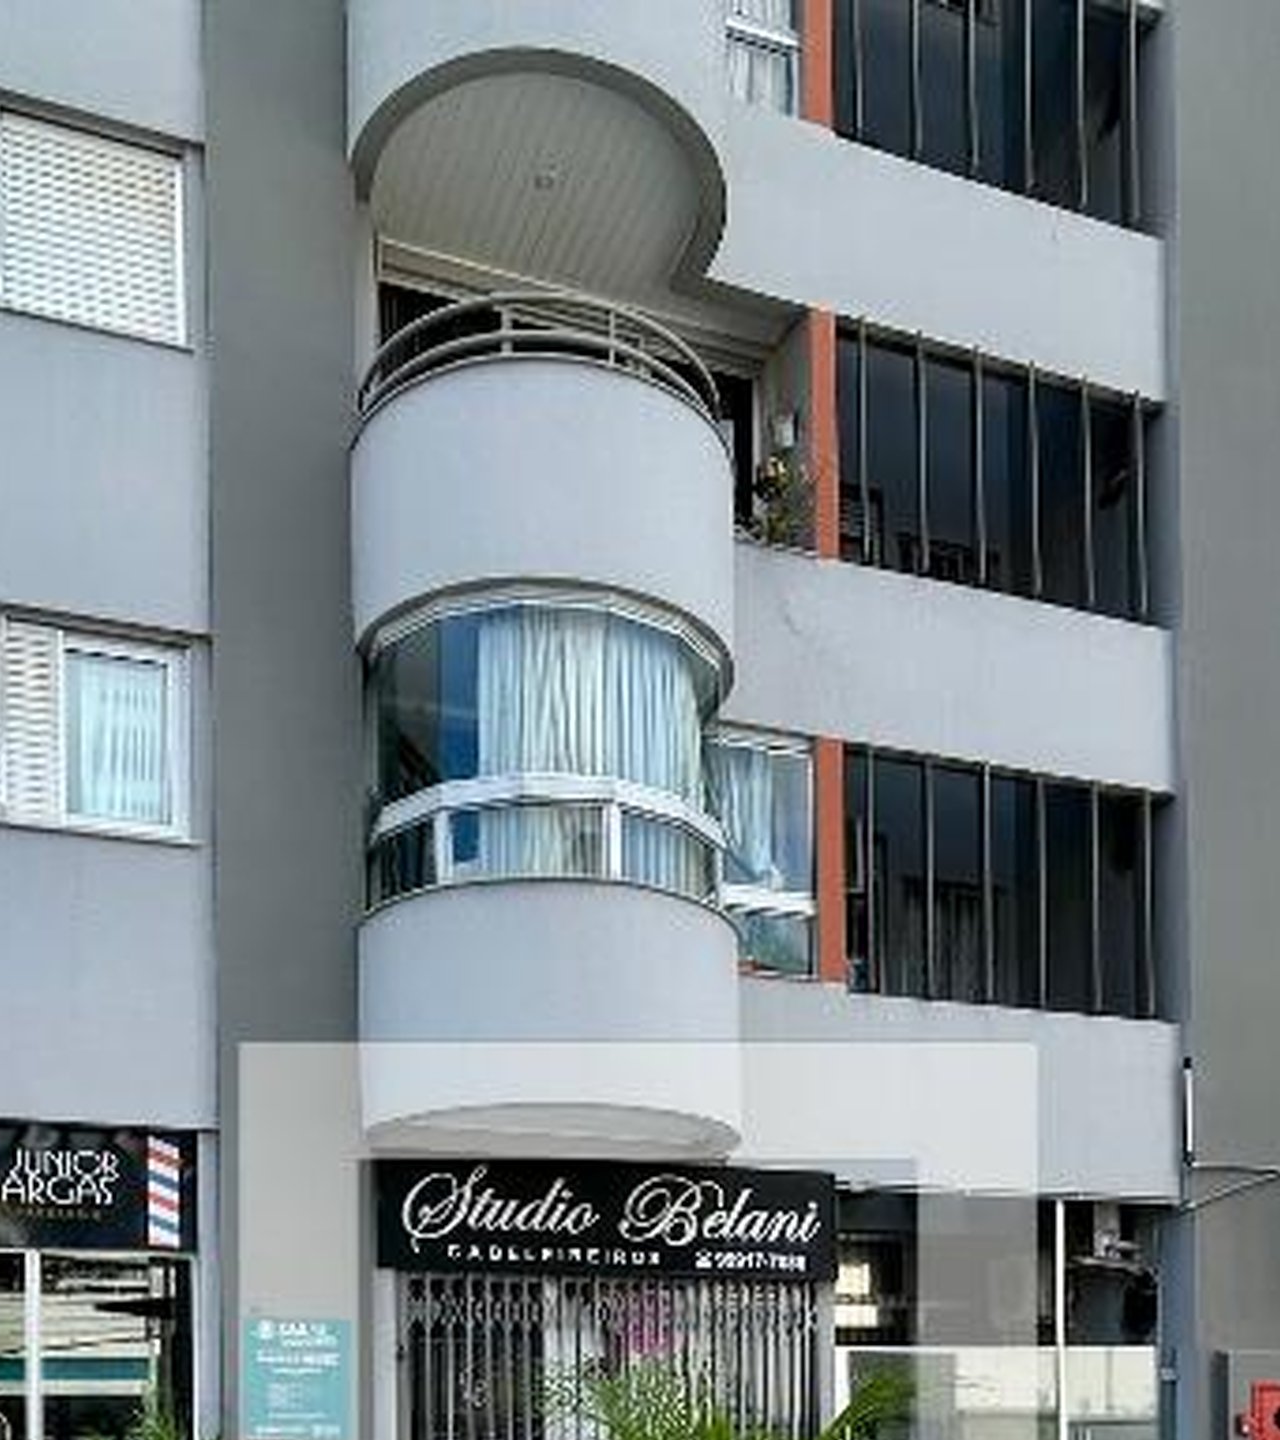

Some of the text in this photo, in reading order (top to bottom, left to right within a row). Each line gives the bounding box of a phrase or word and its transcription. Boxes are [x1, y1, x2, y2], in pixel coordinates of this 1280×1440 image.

[9, 1149, 120, 1178] JUNIOR
[402, 1163, 821, 1254] Studio Belani
